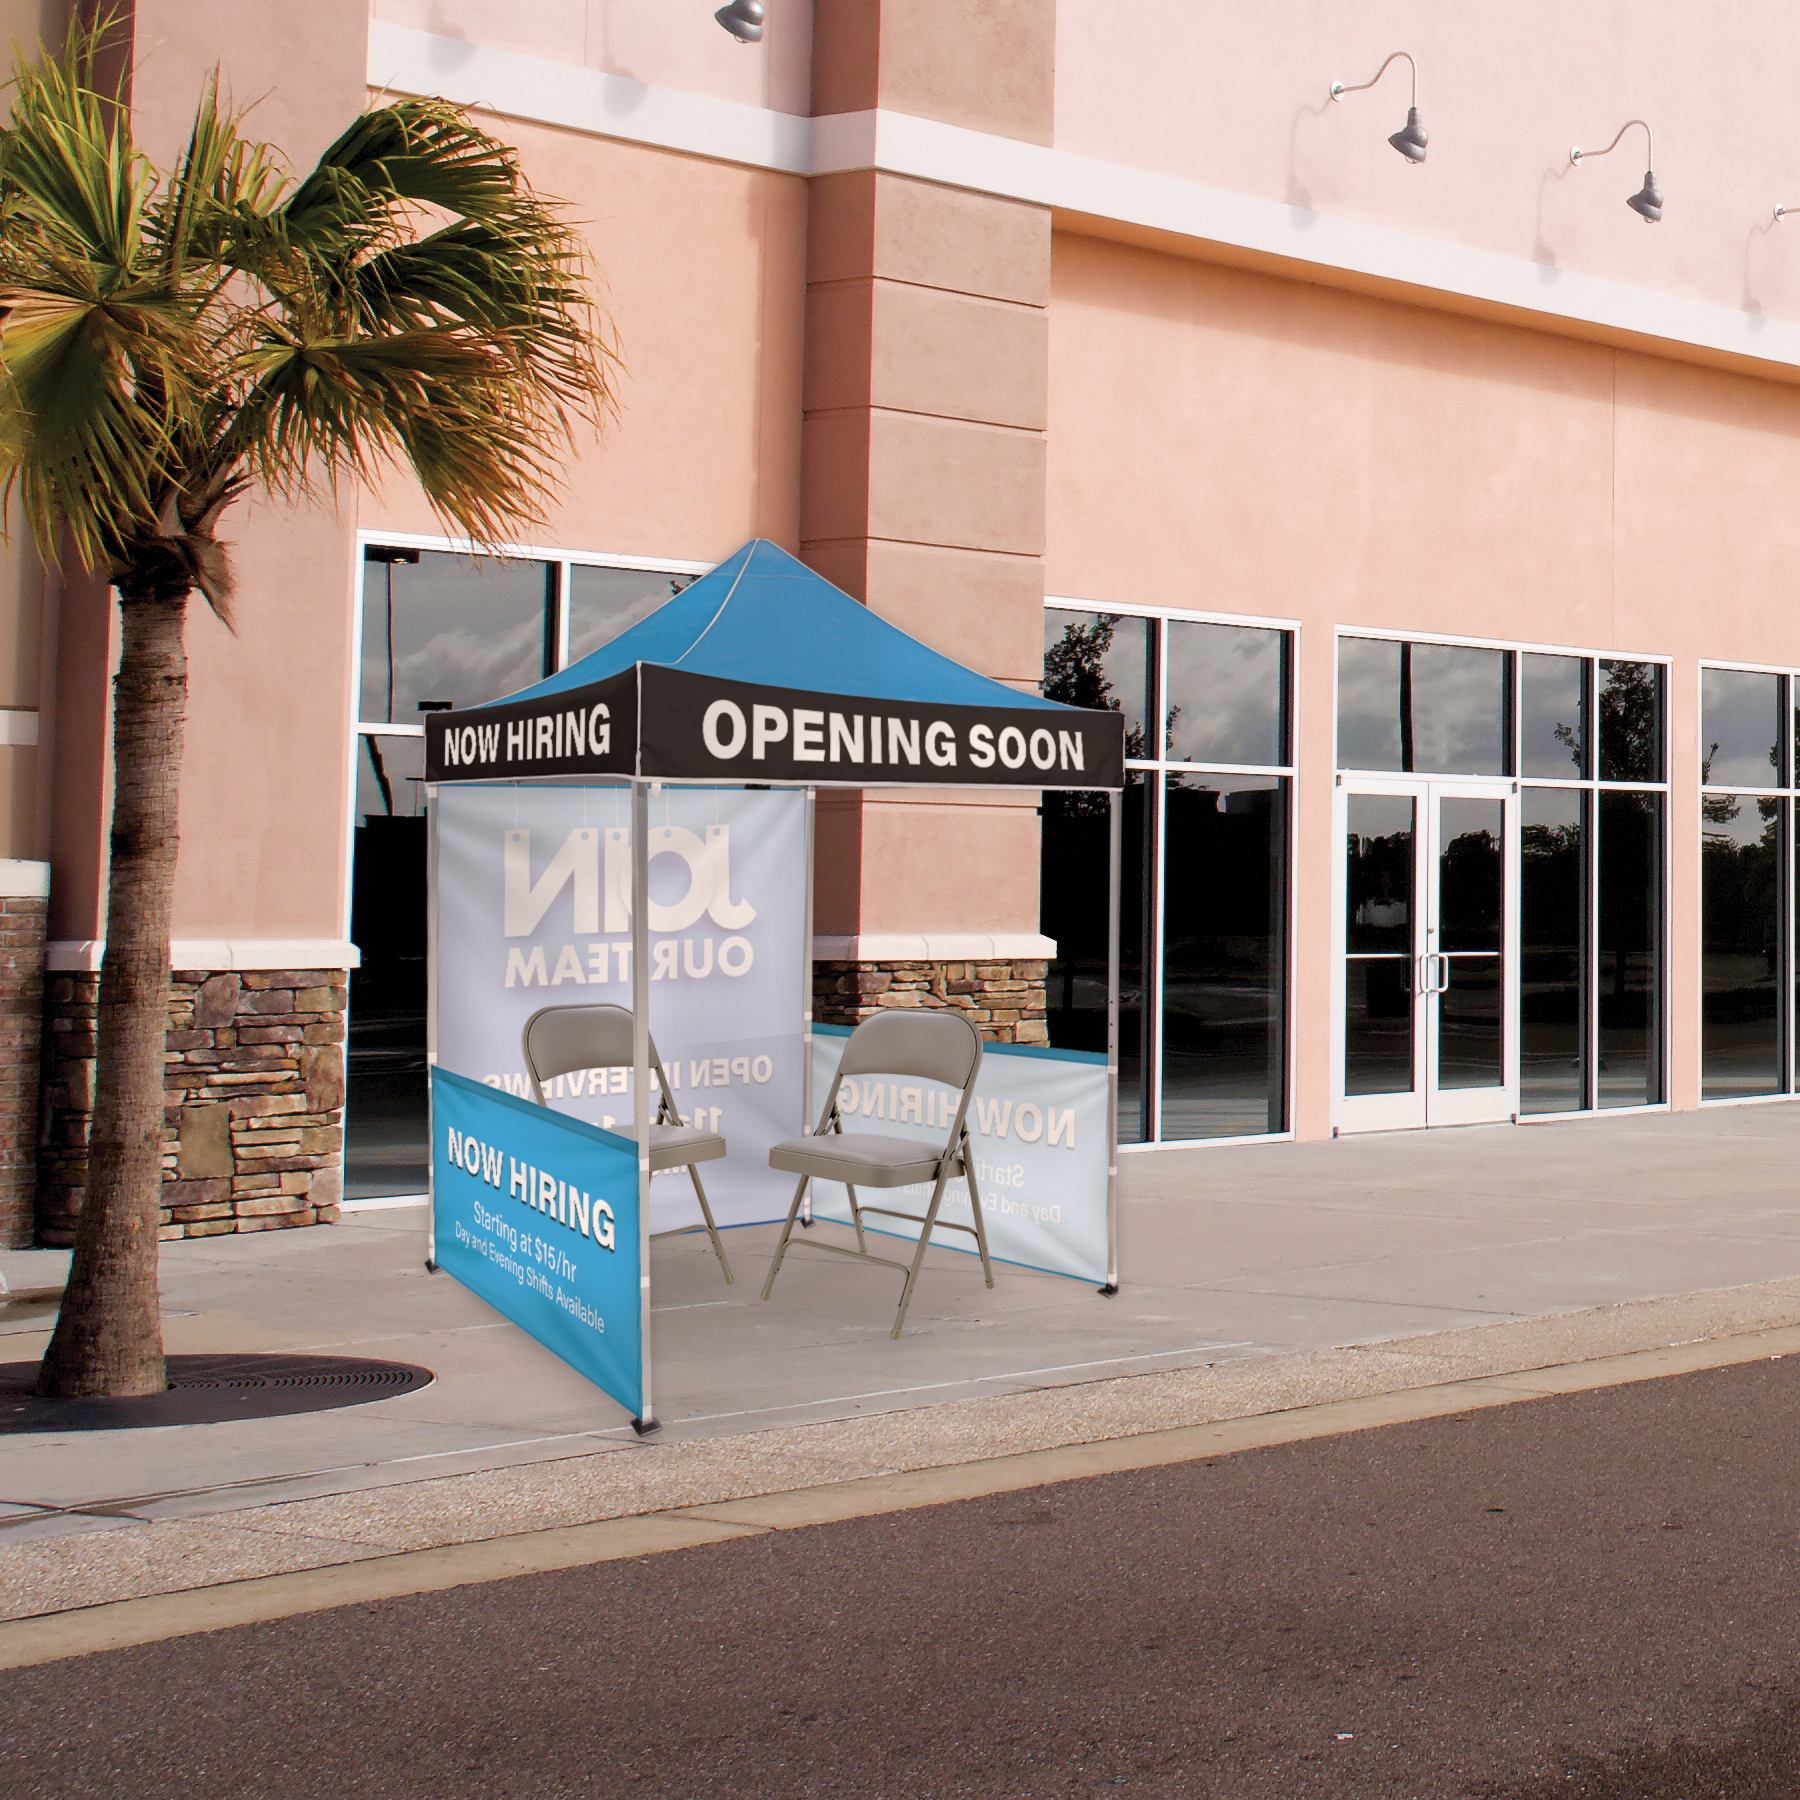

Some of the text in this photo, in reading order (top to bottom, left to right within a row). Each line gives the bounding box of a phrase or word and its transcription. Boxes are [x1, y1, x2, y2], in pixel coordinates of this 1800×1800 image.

[444, 703, 611, 766] NOW HIRING
[702, 699, 1085, 771] OPENING SOON
[447, 1126, 616, 1252] NOW HIRING
[455, 1220, 605, 1334] Day and Evening Shifts Available
[473, 1200, 577, 1283] Starting at $15/hr
